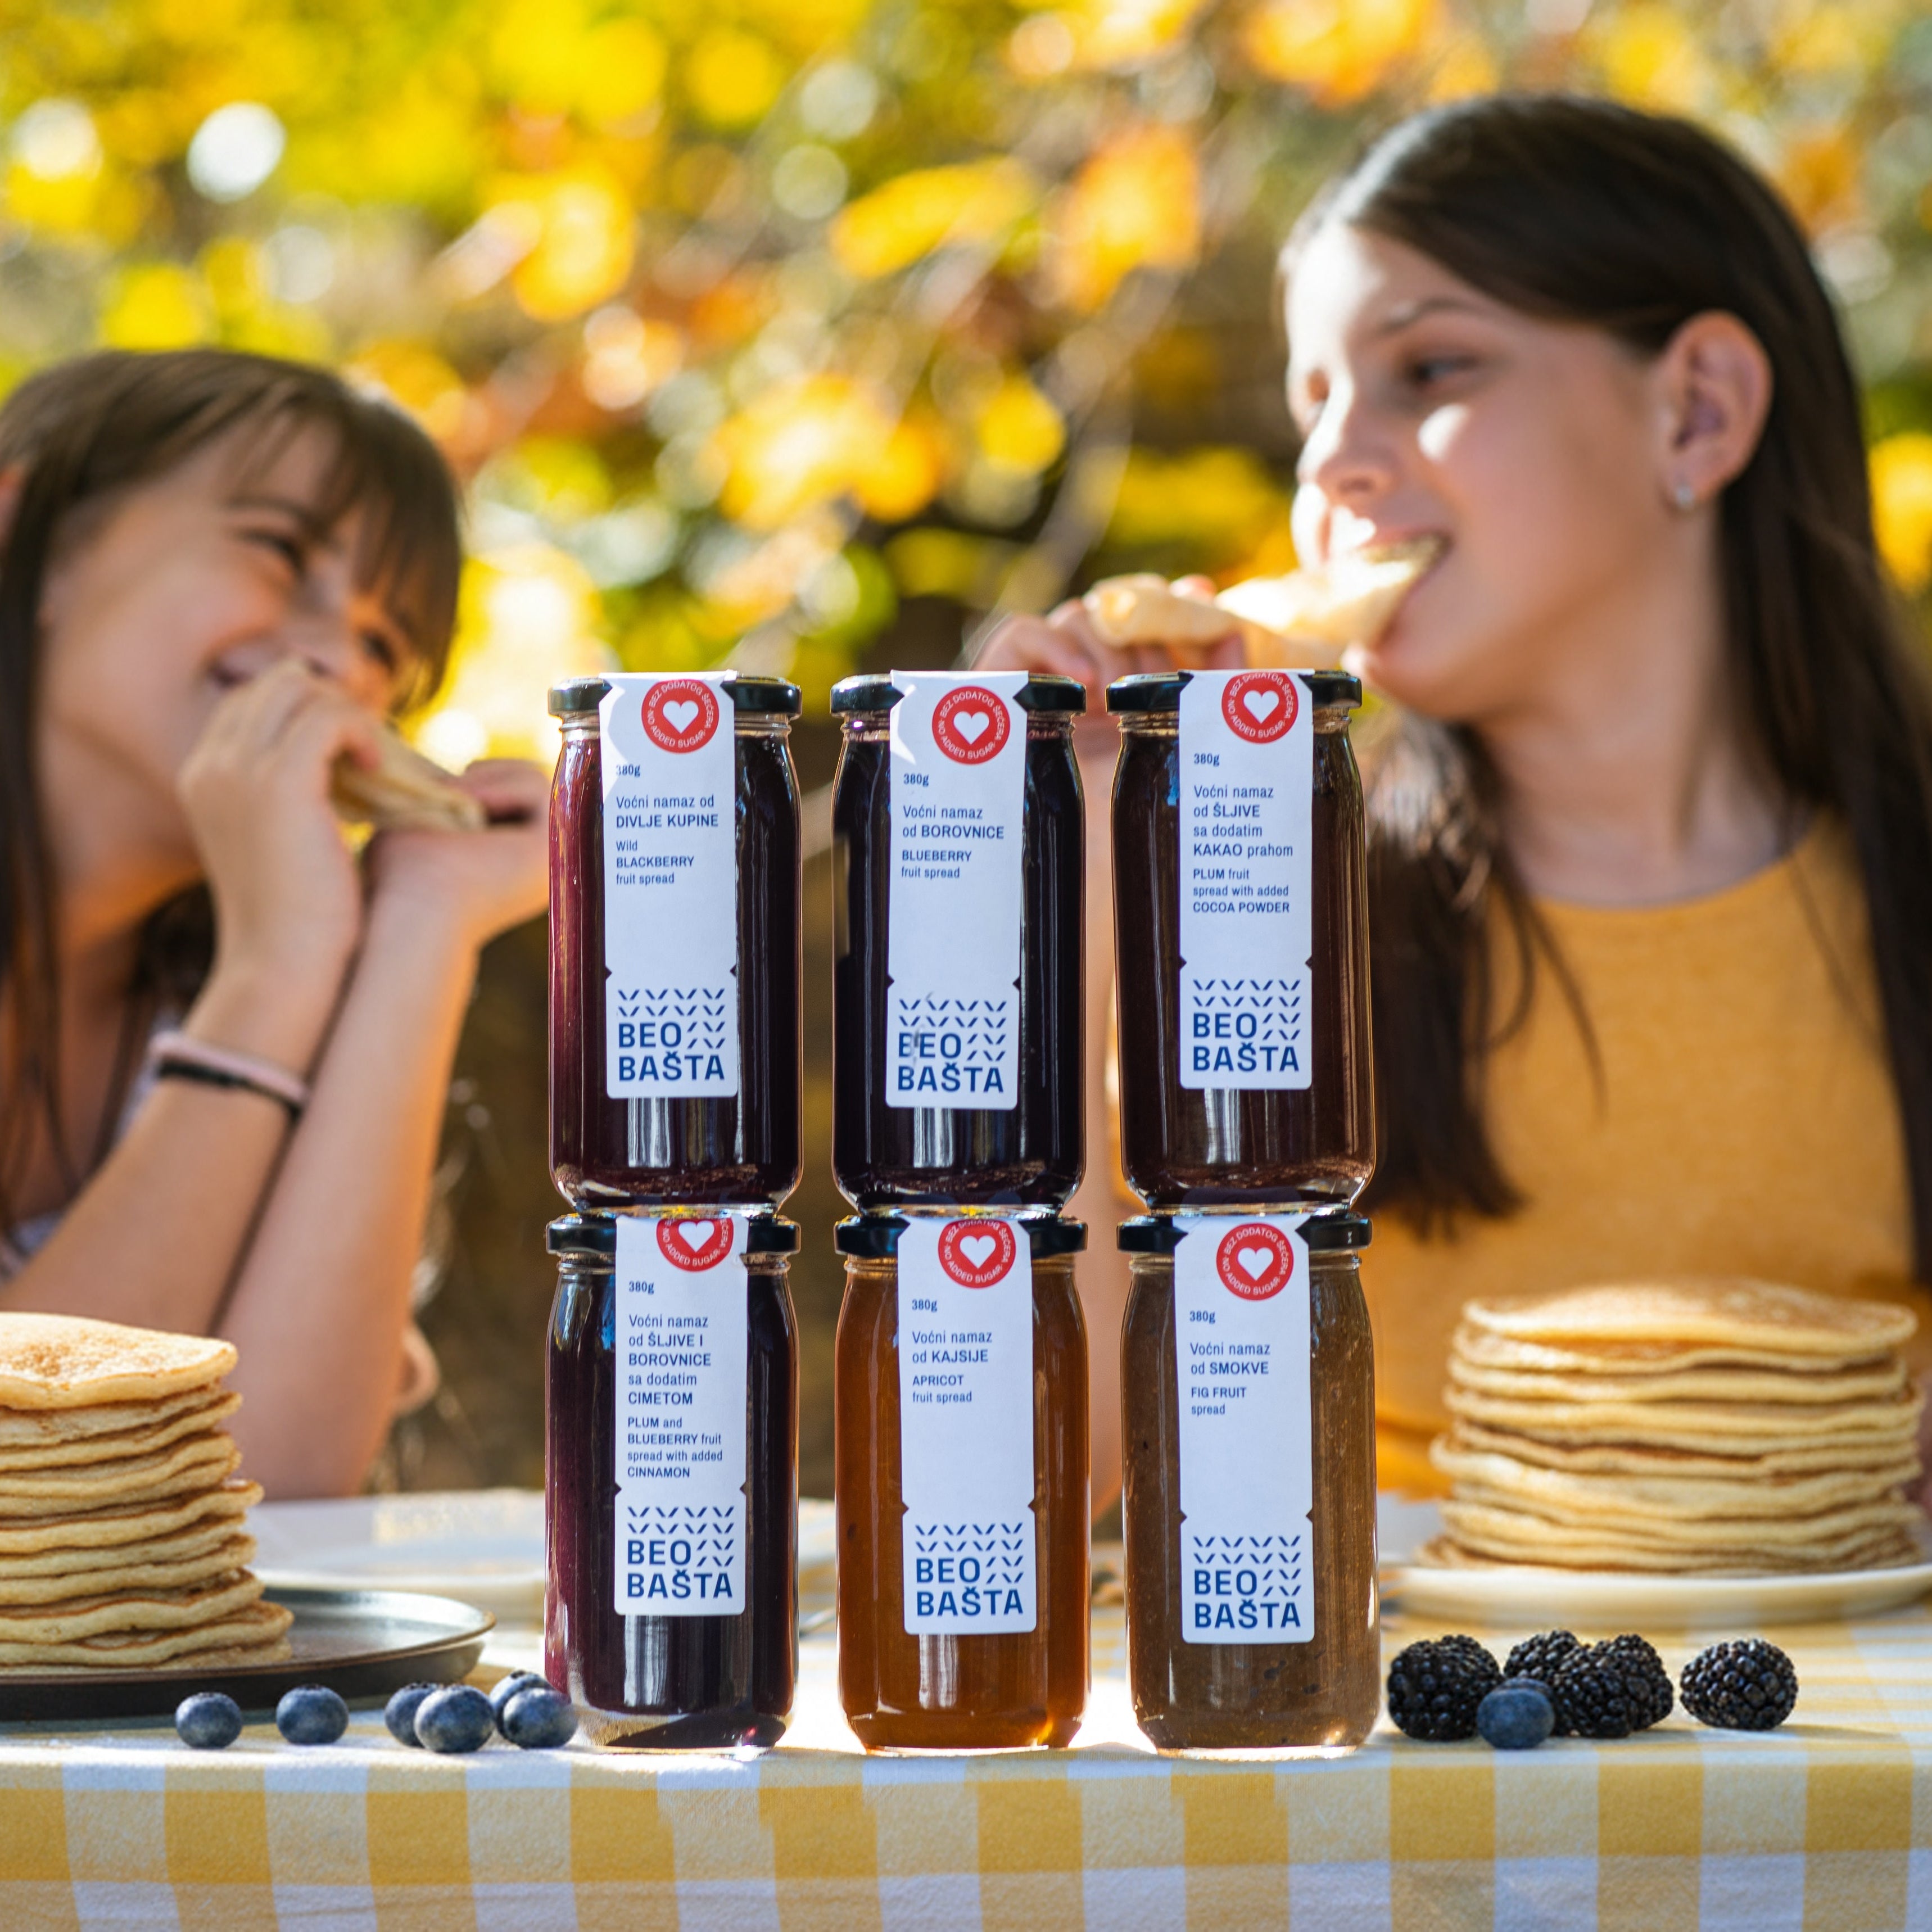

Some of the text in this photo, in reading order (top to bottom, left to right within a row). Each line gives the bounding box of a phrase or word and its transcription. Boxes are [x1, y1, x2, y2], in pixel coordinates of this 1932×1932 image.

[649, 689, 662, 708] BEZ
[661, 680, 703, 696] DODATOG
[1229, 678, 1243, 697] BEZ
[939, 700, 953, 718] BEZ
[952, 690, 994, 707] DODATOG
[1228, 699, 1285, 738] NO ADDED SUGAR
[648, 710, 705, 748] NO ADDED SUGAR
[938, 721, 995, 759] NO ADDED SUGAR
[1193, 753, 1220, 767] 380g
[616, 763, 642, 779] 380g
[903, 773, 929, 788] 380g
[1193, 784, 1274, 799] Voćni namaz
[616, 794, 714, 809] Voćni namaz od
[903, 804, 983, 820] Voćni namaz
[1193, 802, 1260, 818] od ŠLJIVE
[616, 813, 718, 829] DIVLJE KUPINE
[902, 824, 1005, 840] od BOROVNICE
[1193, 824, 1263, 838] sa dodatim
[616, 839, 638, 852] Wild
[1193, 843, 1293, 859] KAKAO prahom
[616, 856, 695, 868] BLACKBERRY
[902, 849, 972, 862] BLUEBERRY
[616, 872, 675, 886] fruit spread
[901, 866, 960, 880] fruit spread
[1193, 867, 1250, 880] PLUM fruit
[1193, 885, 1289, 898] spread with added
[1193, 901, 1289, 913] COCOA POWDER
[1193, 1012, 1257, 1039] BEO
[618, 1021, 682, 1048] BEO
[898, 1032, 962, 1060] BEO
[1193, 1039, 1300, 1073] BAŠTA
[619, 1051, 725, 1082] BAŠTA
[898, 1060, 1004, 1093] BAŠTA
[945, 1225, 960, 1243] BEZ
[1224, 1237, 1238, 1255] BEZ
[1236, 1227, 1278, 1243] DODATOG
[663, 1228, 720, 1266] NO ADDED SUGAR
[944, 1246, 1002, 1283] NO ADDED SUGAR
[1223, 1257, 1280, 1295] NO ADDED SUGAR
[628, 1281, 655, 1295] 380g
[912, 1299, 938, 1313] 380g
[628, 1314, 708, 1328] Voćni namaz
[1189, 1310, 1216, 1324] 380g
[628, 1331, 703, 1347] od ŠLJIVE I
[912, 1330, 992, 1344] Voćni namaz
[912, 1349, 988, 1364] od KAJSIJE
[1189, 1342, 1270, 1356] Voćni namaz
[628, 1352, 711, 1367] BOROVNICE
[1191, 1361, 1269, 1376] od SMOKVE
[628, 1372, 697, 1386] sa dodatim
[912, 1374, 964, 1386] APRICOT
[628, 1391, 693, 1405] CIMETOM
[912, 1390, 972, 1405] fruit spread
[1191, 1386, 1247, 1399] FIG FRUIT
[1191, 1403, 1225, 1417] spread
[627, 1417, 682, 1428] PLUM and
[627, 1433, 721, 1445] BLUEBERRY fruit
[627, 1449, 723, 1463] spread with added
[627, 1467, 690, 1478] CINNAMON
[627, 1539, 691, 1567] BEO
[916, 1557, 980, 1583] BEO
[627, 1565, 733, 1599] BAŠTA
[1194, 1569, 1257, 1596] BEO
[917, 1586, 1024, 1617] BAŠTA
[1195, 1599, 1301, 1630] BAŠTA
